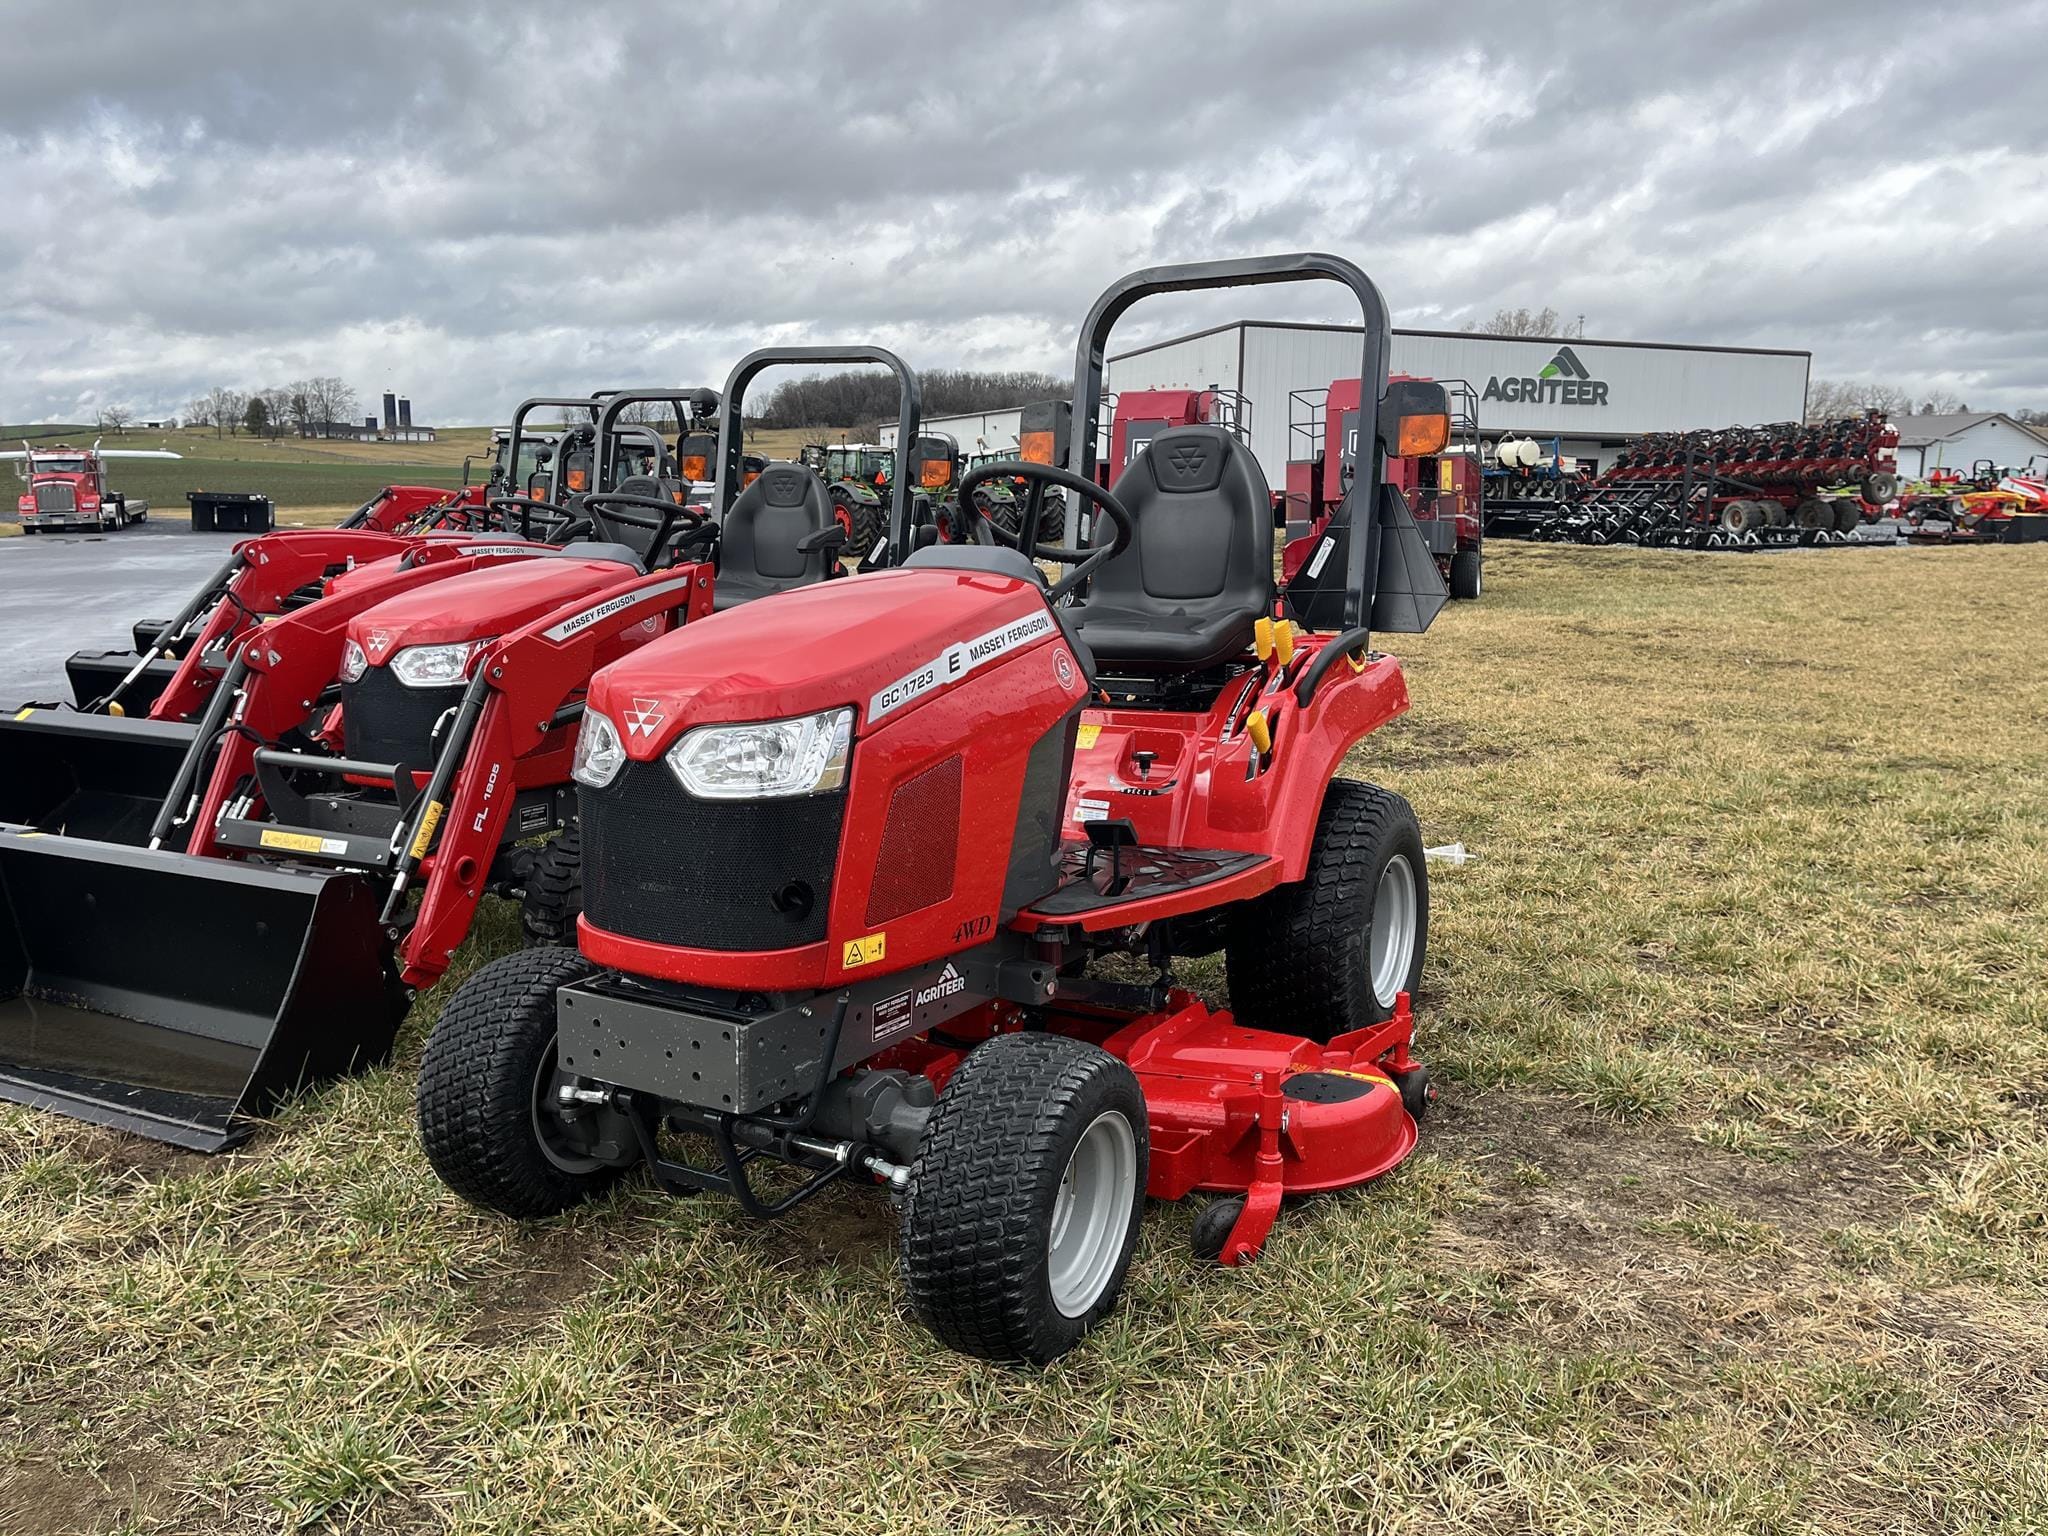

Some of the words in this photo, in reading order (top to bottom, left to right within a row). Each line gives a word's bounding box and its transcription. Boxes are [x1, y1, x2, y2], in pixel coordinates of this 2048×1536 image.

[1480, 376, 1609, 406] AGRITEER
[471, 548, 495, 556] MASSEY
[495, 547, 525, 555] FERGUSON
[563, 611, 595, 634] MASSEY
[596, 594, 636, 617] FERGUSON
[881, 688, 900, 709] GC
[902, 669, 934, 697] 1723
[949, 652, 961, 674] E
[969, 634, 1007, 662] MASSEY
[1008, 615, 1049, 643] FERGUSON
[473, 807, 489, 833] FL
[483, 763, 500, 801] 1805
[952, 915, 991, 943] 4WD
[915, 976, 965, 1007] AGRITEER
